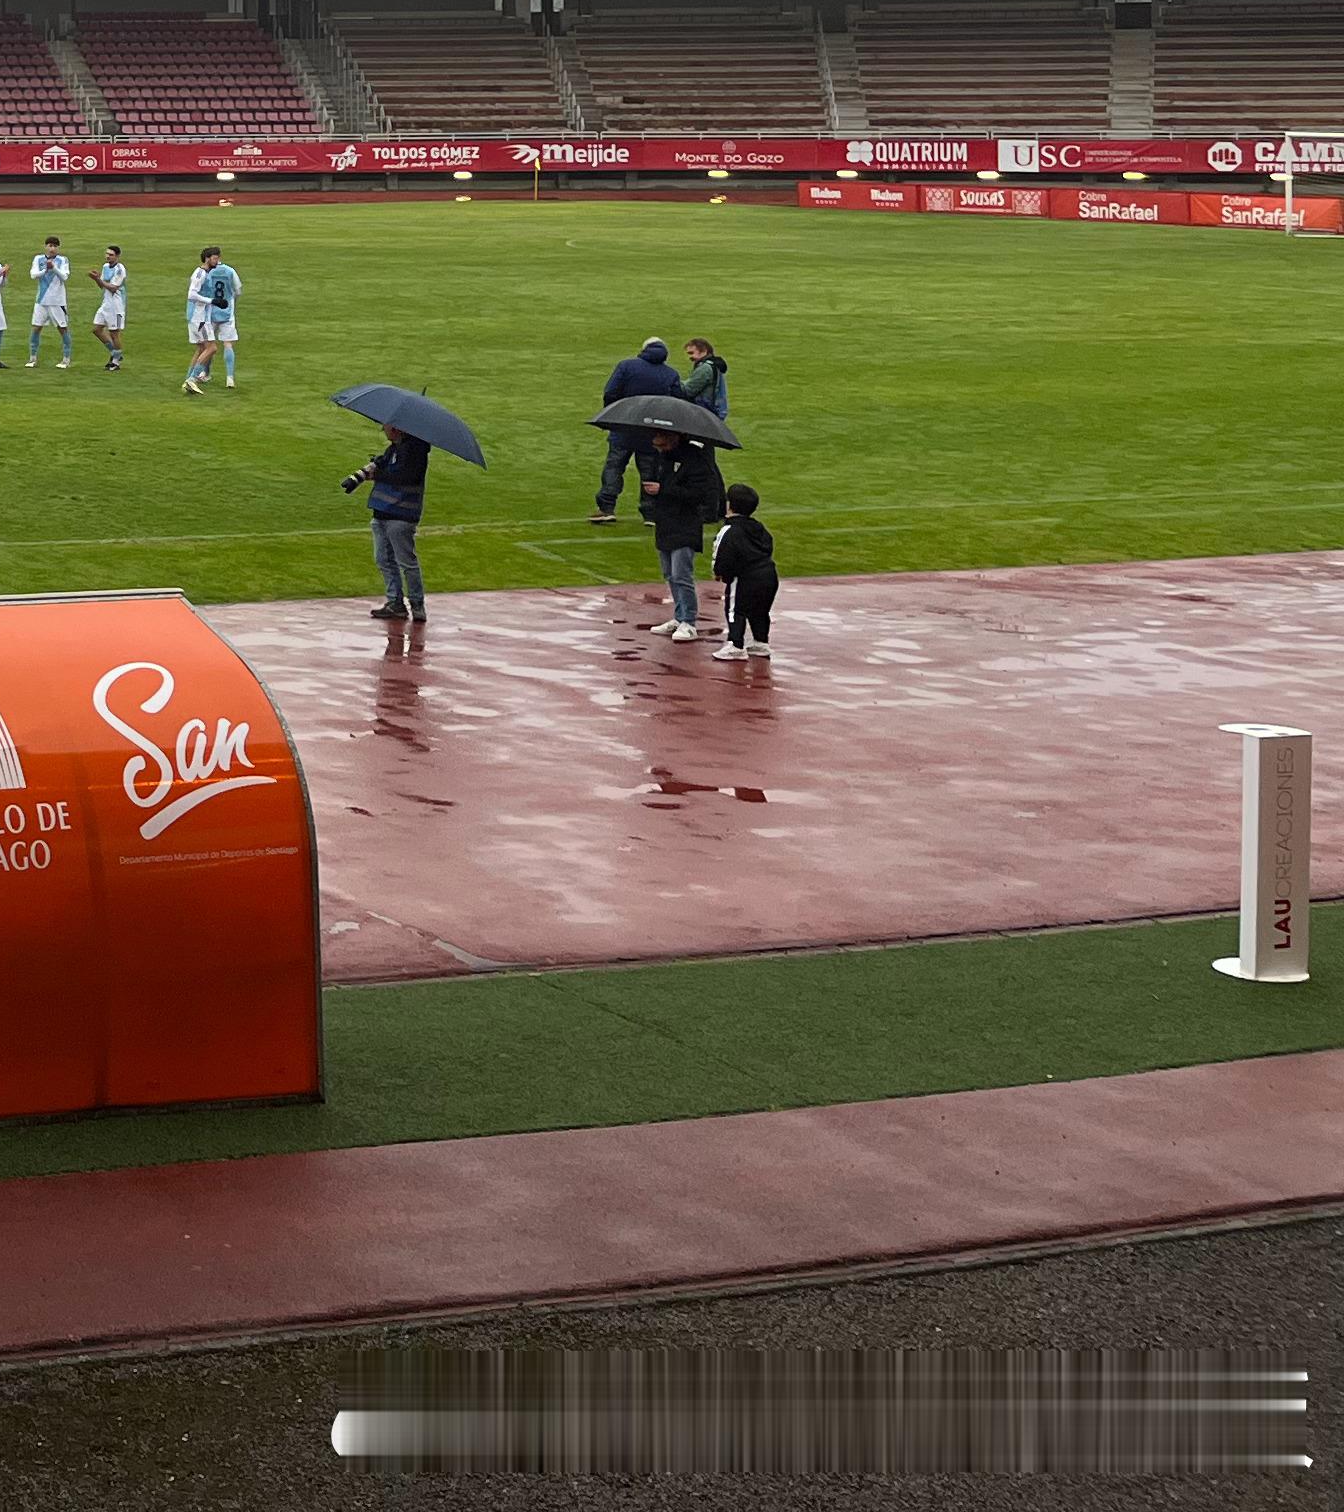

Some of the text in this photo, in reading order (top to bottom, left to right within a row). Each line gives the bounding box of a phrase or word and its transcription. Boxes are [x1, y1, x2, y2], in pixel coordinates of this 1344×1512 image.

[112, 148, 147, 157] OBRAS E
[372, 143, 480, 159] TOLDOS GÓMEZ
[675, 152, 719, 163] MONTE
[747, 152, 785, 163] GOZO
[875, 141, 968, 163] QUATRIUM
[1013, 145, 1082, 168] USC
[112, 159, 158, 169] REFORMAS
[1255, 162, 1309, 173] FITNSS
[960, 189, 1005, 207] SOUSAS
[1078, 190, 1107, 202] Cobre
[1221, 194, 1252, 207] Cobre
[1078, 201, 1159, 221] SanRafael
[215, 280, 225, 298] 8
[92, 661, 256, 808] San
[37, 802, 71, 831] DE
